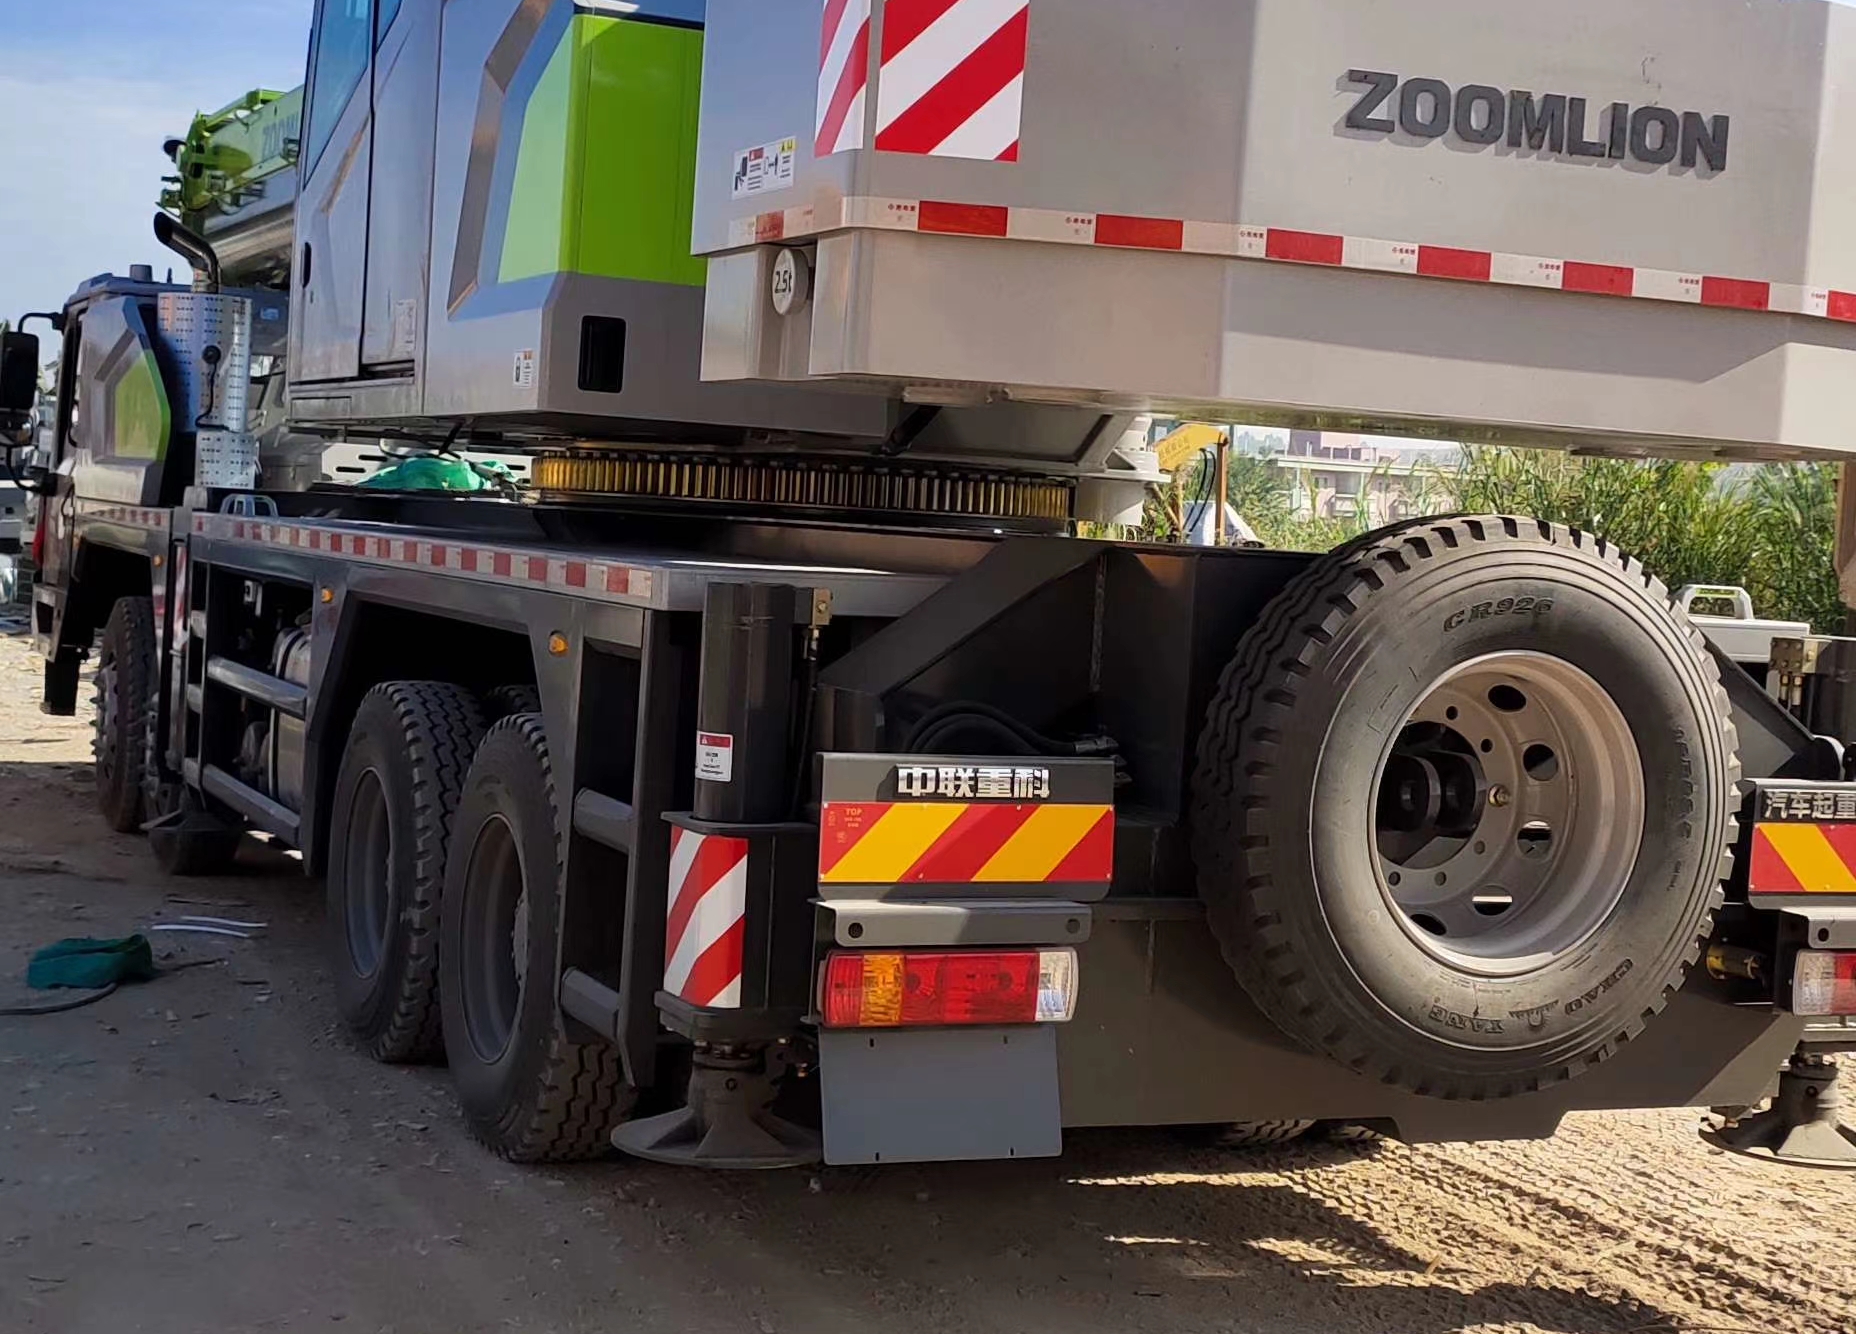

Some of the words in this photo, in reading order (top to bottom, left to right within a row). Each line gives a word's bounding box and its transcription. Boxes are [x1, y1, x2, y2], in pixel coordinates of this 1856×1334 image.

[1344, 68, 1730, 173] ZOOMLION
[1443, 597, 1555, 632] CR926
[897, 765, 1050, 799] 中联重科
[845, 808, 863, 816] TOP
[1765, 791, 1856, 819] 汽车起重
